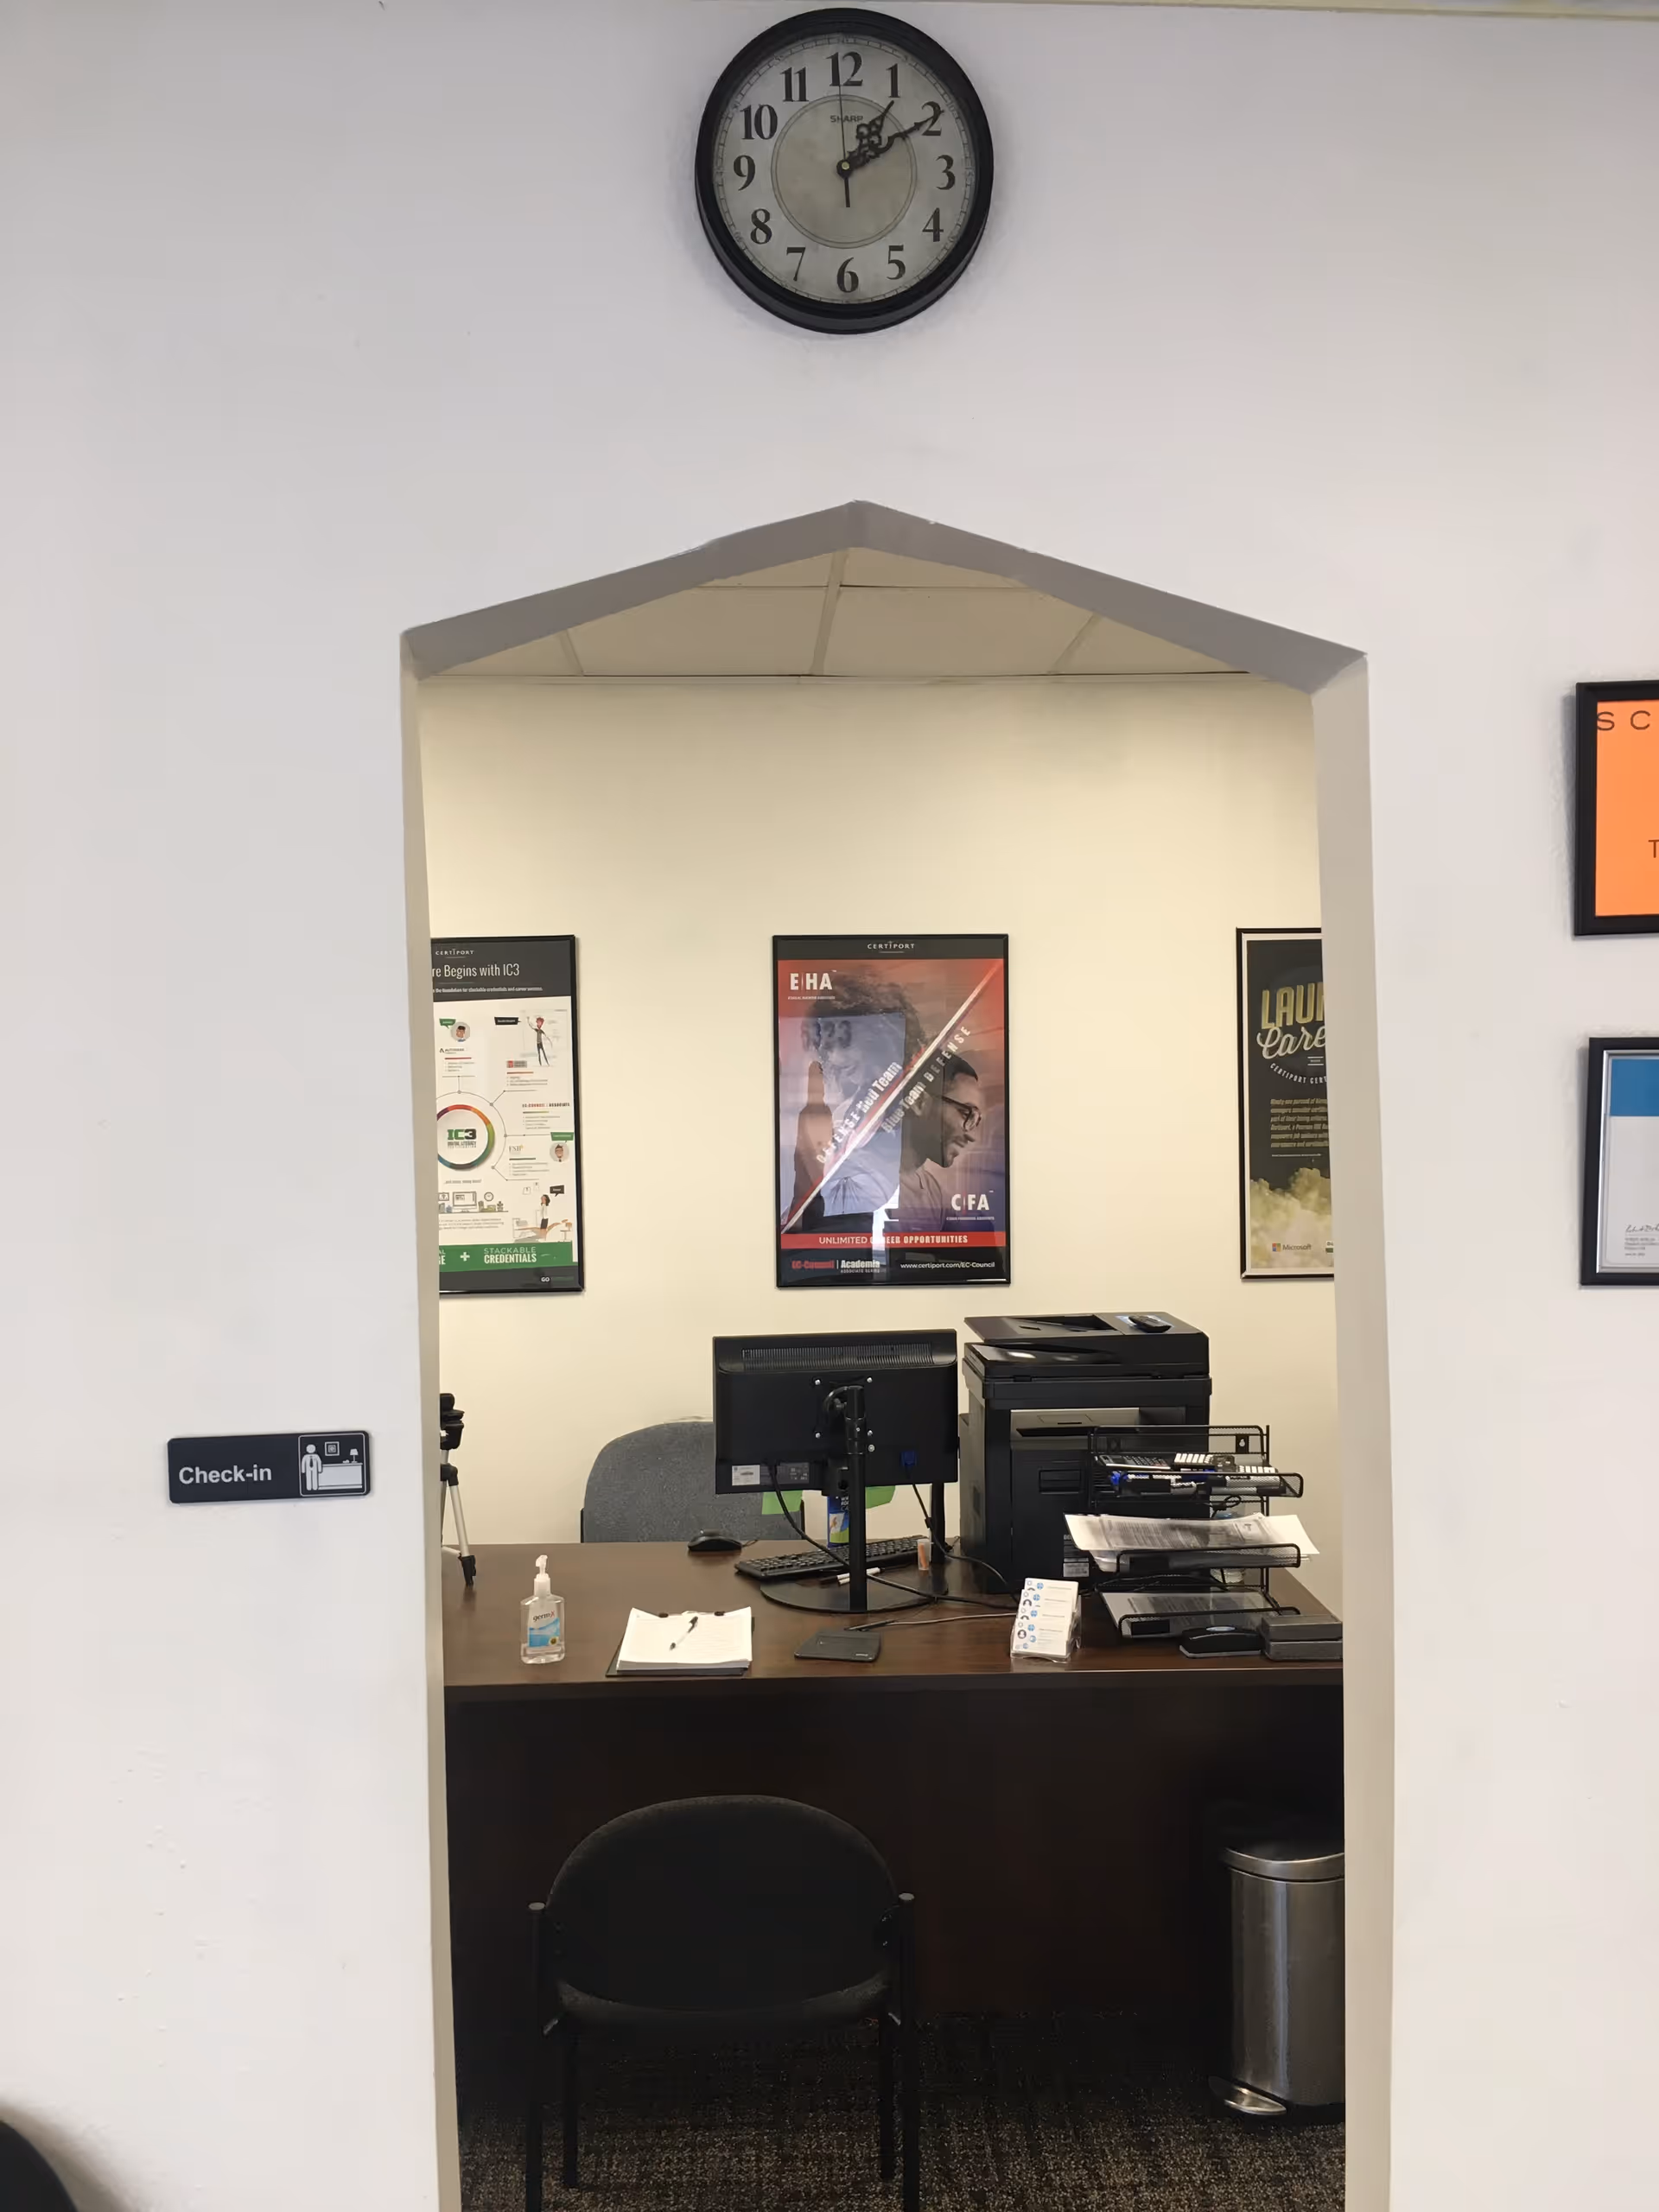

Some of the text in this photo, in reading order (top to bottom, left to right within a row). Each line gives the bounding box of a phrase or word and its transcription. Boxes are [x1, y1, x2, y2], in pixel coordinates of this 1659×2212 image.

[779, 67, 810, 102] 11
[826, 52, 863, 86] 12
[885, 63, 900, 99] 1
[740, 104, 778, 140] 10
[921, 101, 943, 136] 2
[733, 155, 756, 191] 9
[936, 154, 956, 190] 3
[750, 208, 772, 245] 8
[922, 207, 944, 242] 4
[786, 246, 806, 281] 7
[836, 257, 859, 293] 6
[887, 245, 906, 280] 5
[867, 941, 915, 950] CERTIPORT
[444, 964, 477, 980] Begins
[480, 963, 500, 976] with
[503, 963, 520, 976] IC3
[872, 1062, 903, 1091] Team
[899, 1081, 926, 1109] Team
[924, 1027, 971, 1082] DEFENSE
[1269, 1063, 1306, 1084] CERTIPORT
[447, 1128, 477, 1141] IC3
[819, 1236, 868, 1244] UNLIMITED
[903, 1235, 969, 1244] OPPORTUNITIES
[484, 1253, 537, 1264] CREDENTIALS
[841, 1259, 880, 1268] Academia
[900, 1262, 995, 1270] www.certiport.com/EC-Council
[179, 1464, 272, 1484] Check-in
